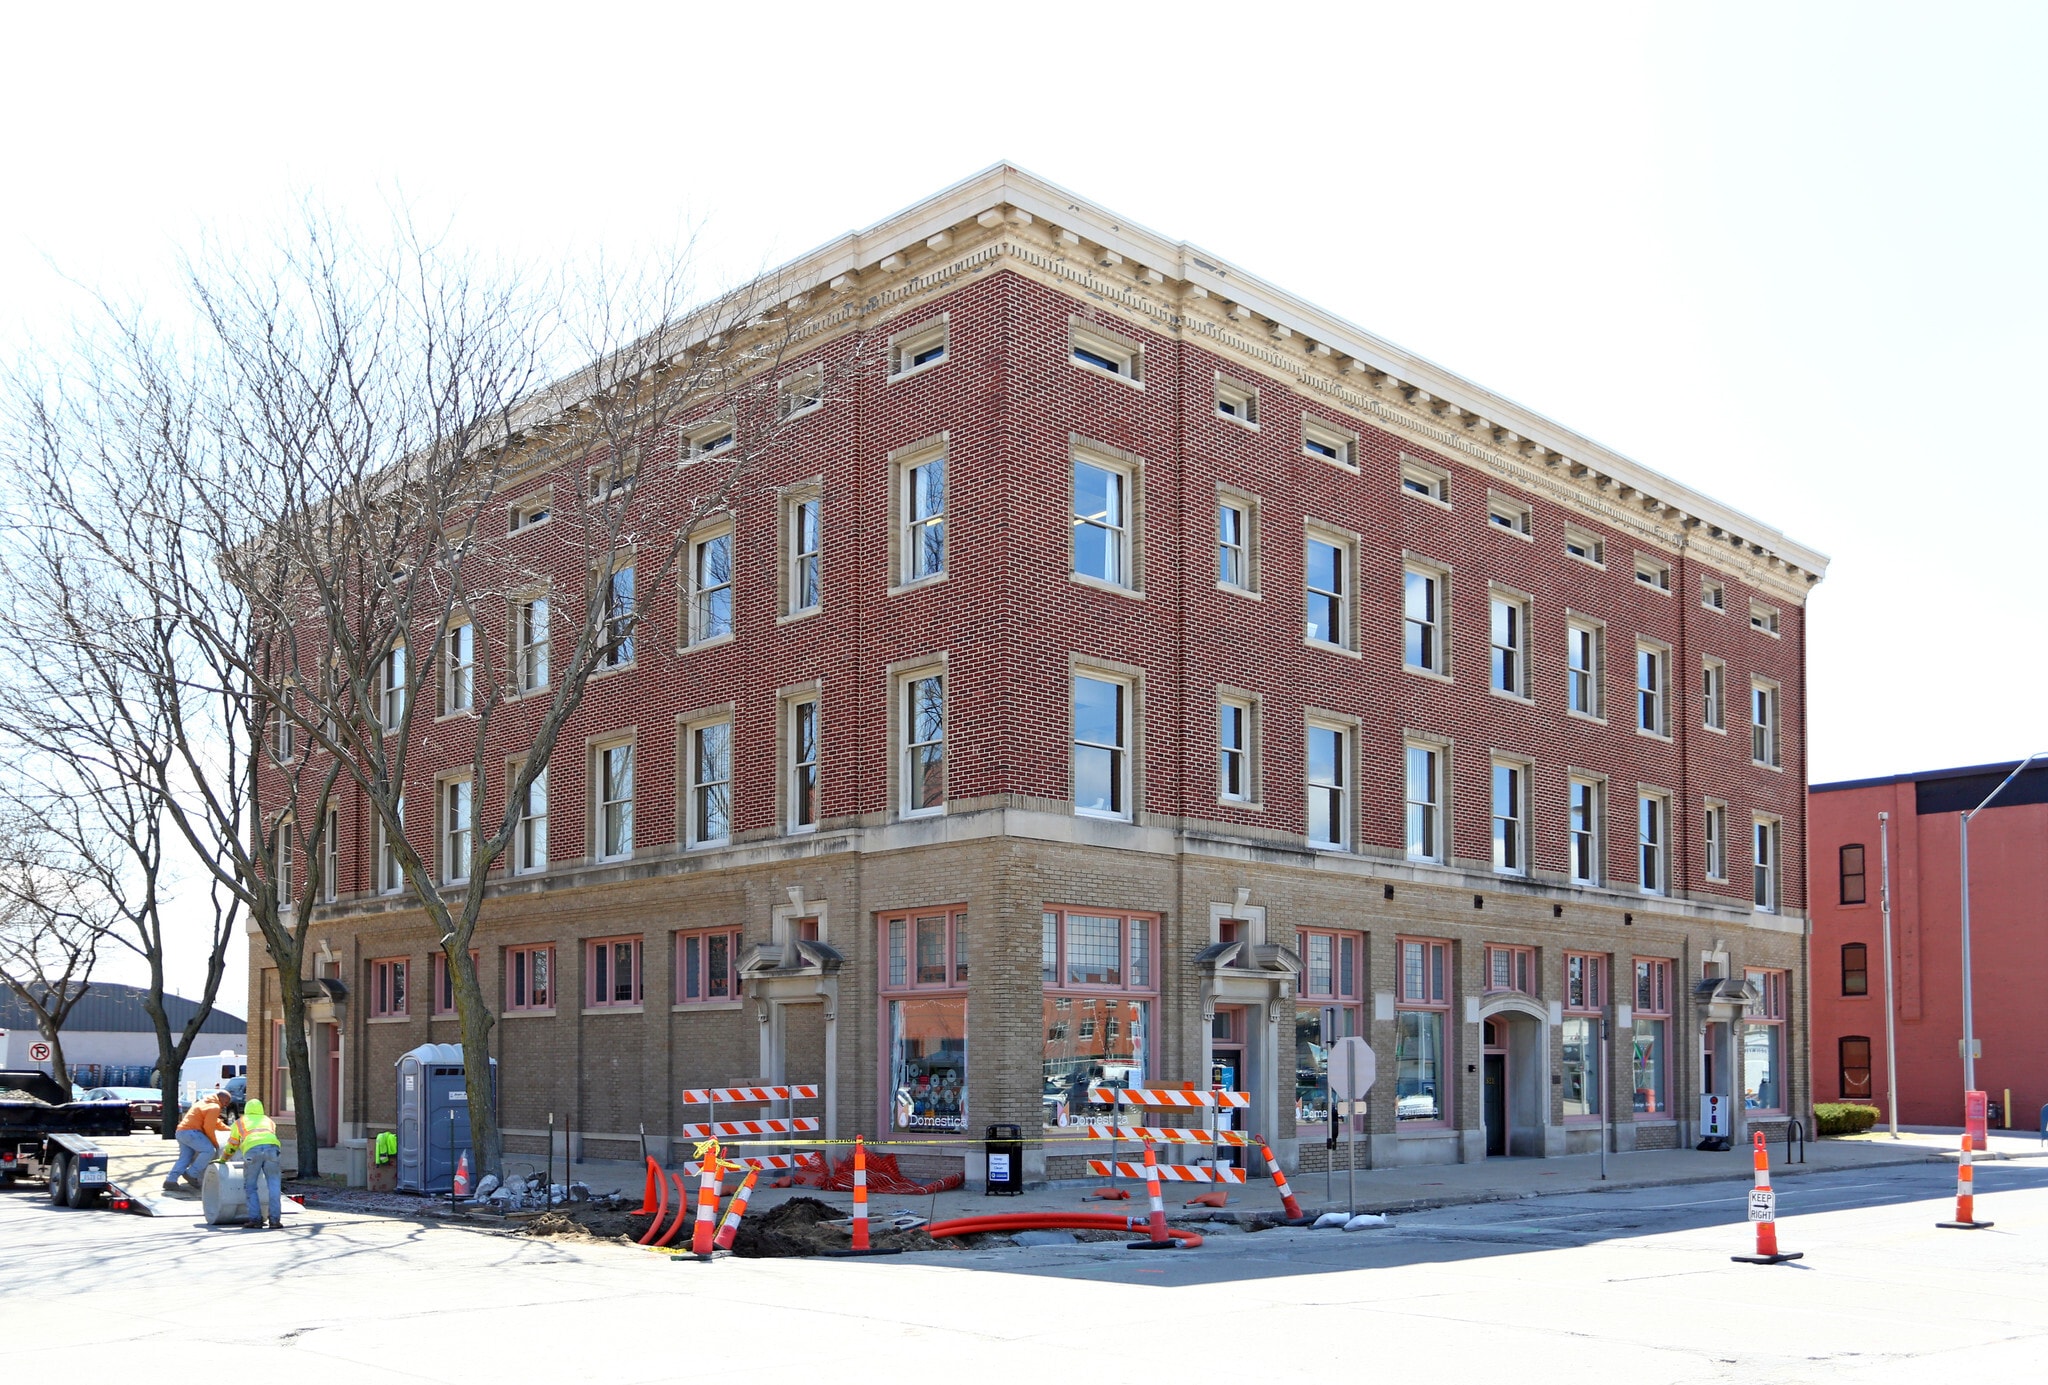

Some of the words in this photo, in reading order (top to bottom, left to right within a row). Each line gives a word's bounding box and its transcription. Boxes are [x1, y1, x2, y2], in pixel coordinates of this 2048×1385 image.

[909, 1114, 968, 1127] Domestica
[1069, 1114, 1129, 1127] Domestca
[1710, 1096, 1718, 1134] OPEN
[1751, 1193, 1772, 1203] KEEP
[1750, 1209, 1772, 1220] RIGHT
